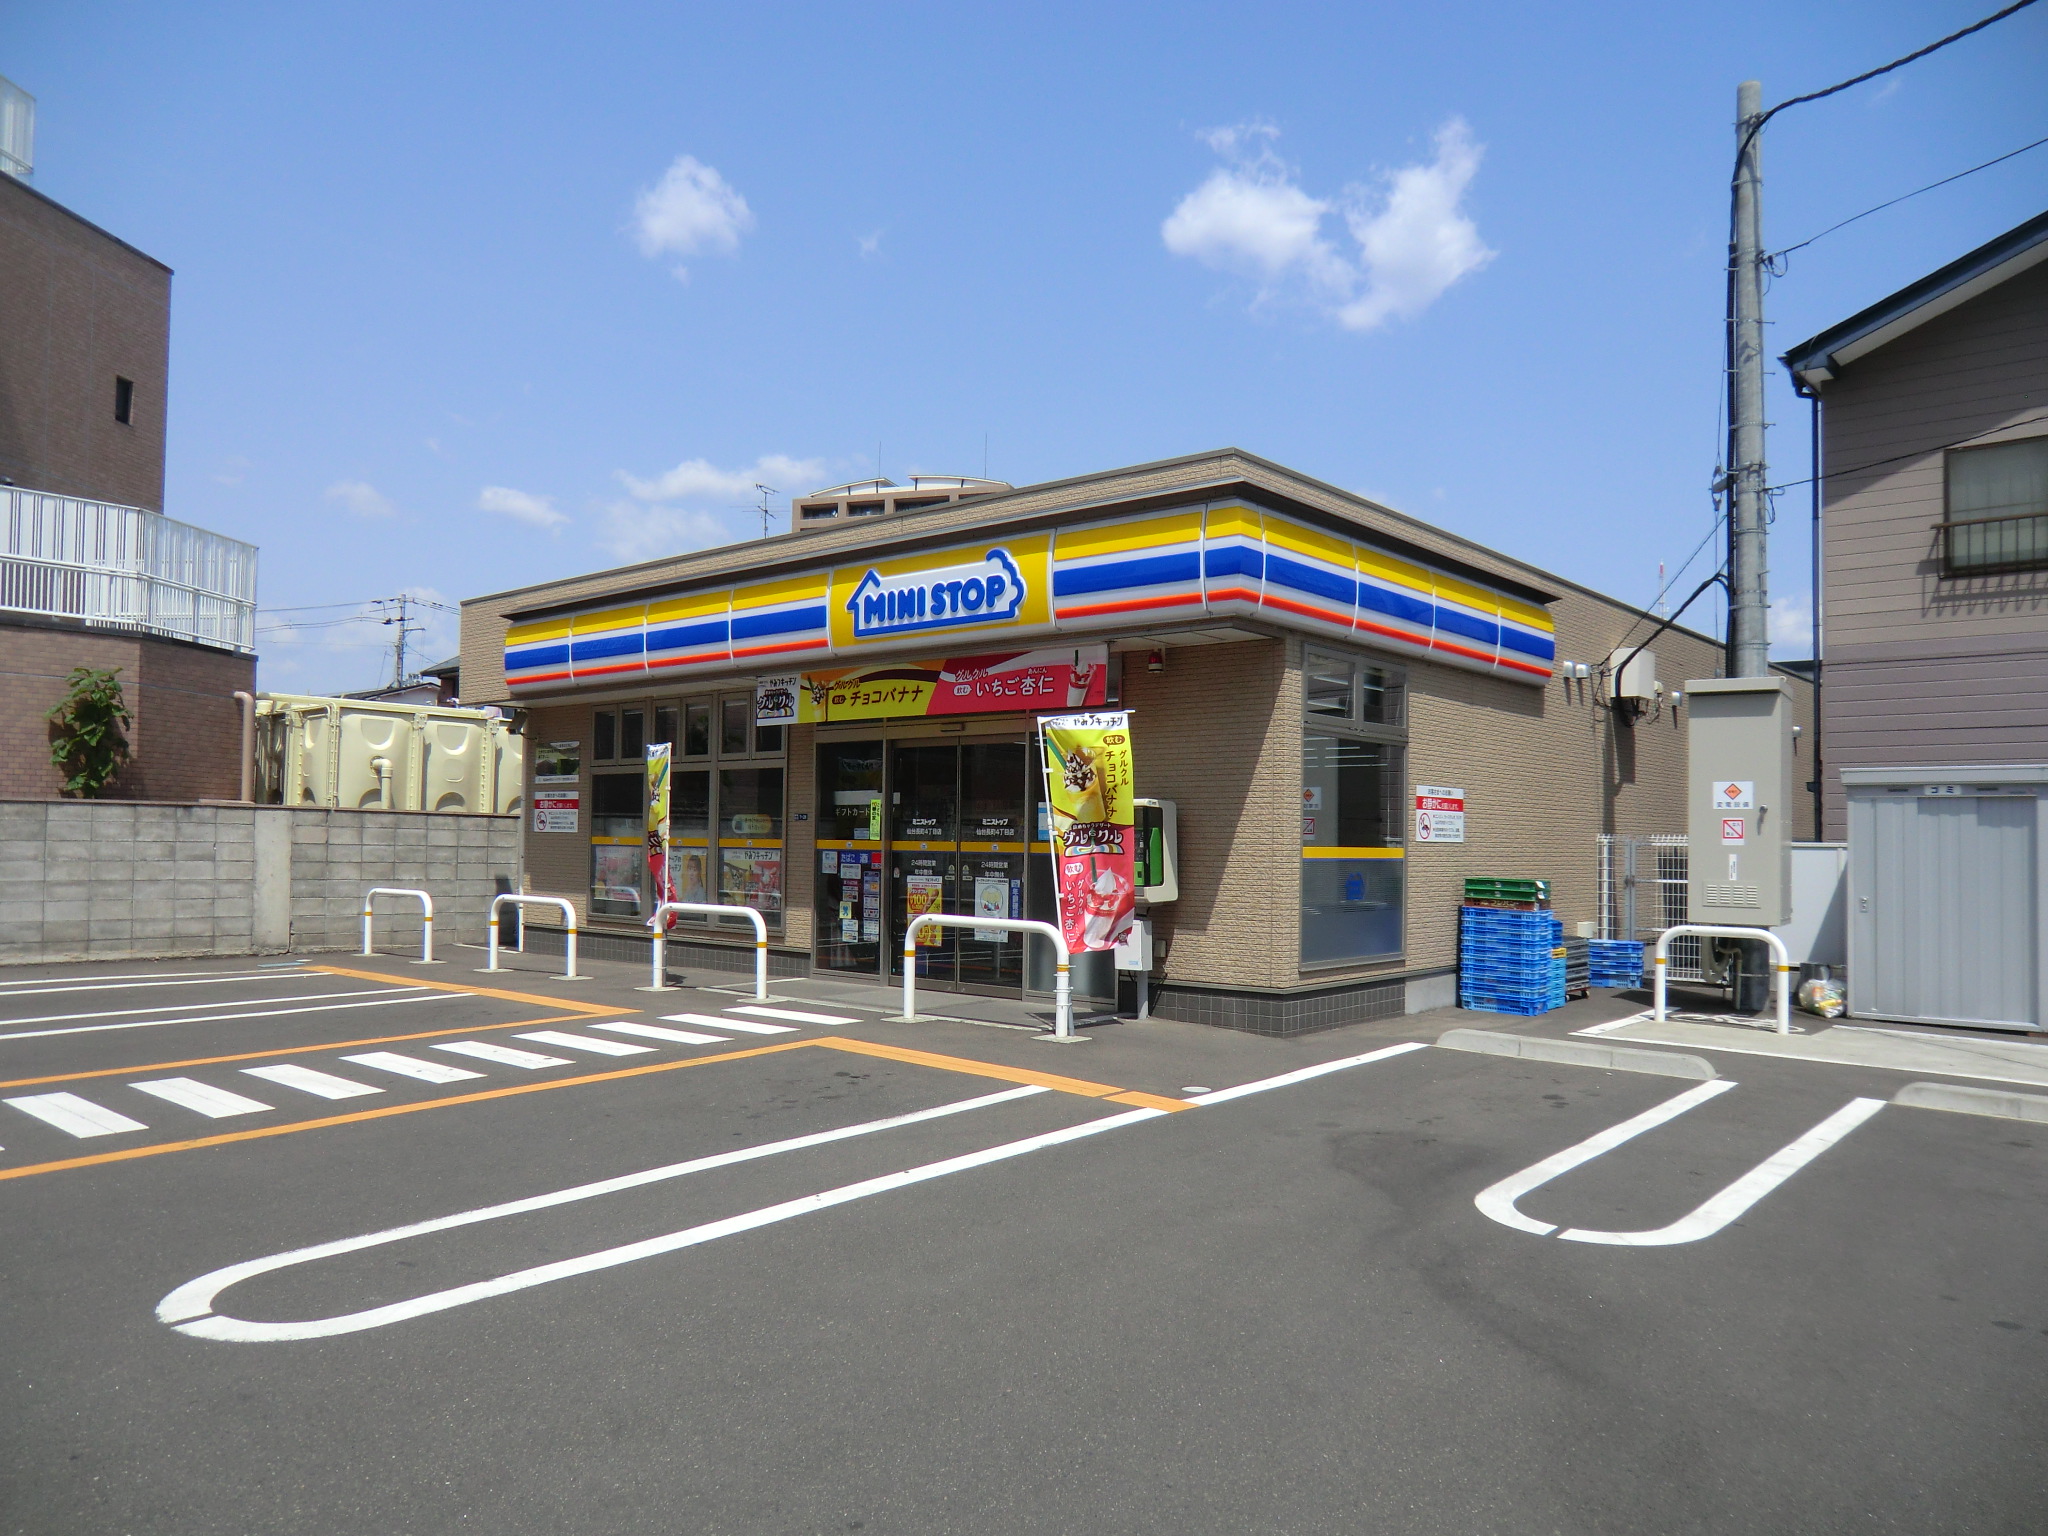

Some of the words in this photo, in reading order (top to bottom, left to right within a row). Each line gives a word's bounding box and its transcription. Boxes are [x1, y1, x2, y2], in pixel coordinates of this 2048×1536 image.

[863, 586, 926, 625] MINI
[930, 574, 1007, 616] STOP
[850, 684, 923, 707] チョコバナナ
[976, 675, 1054, 697] いちご杏仁
[1105, 736, 1123, 744] 飲む
[1104, 750, 1118, 819] チョコバナナ
[912, 818, 937, 826] ミニストップ
[982, 818, 1009, 826] ミニストップ
[841, 853, 856, 863] たばこ
[860, 853, 869, 864] 酒
[1064, 881, 1077, 944] いちご杏仁
